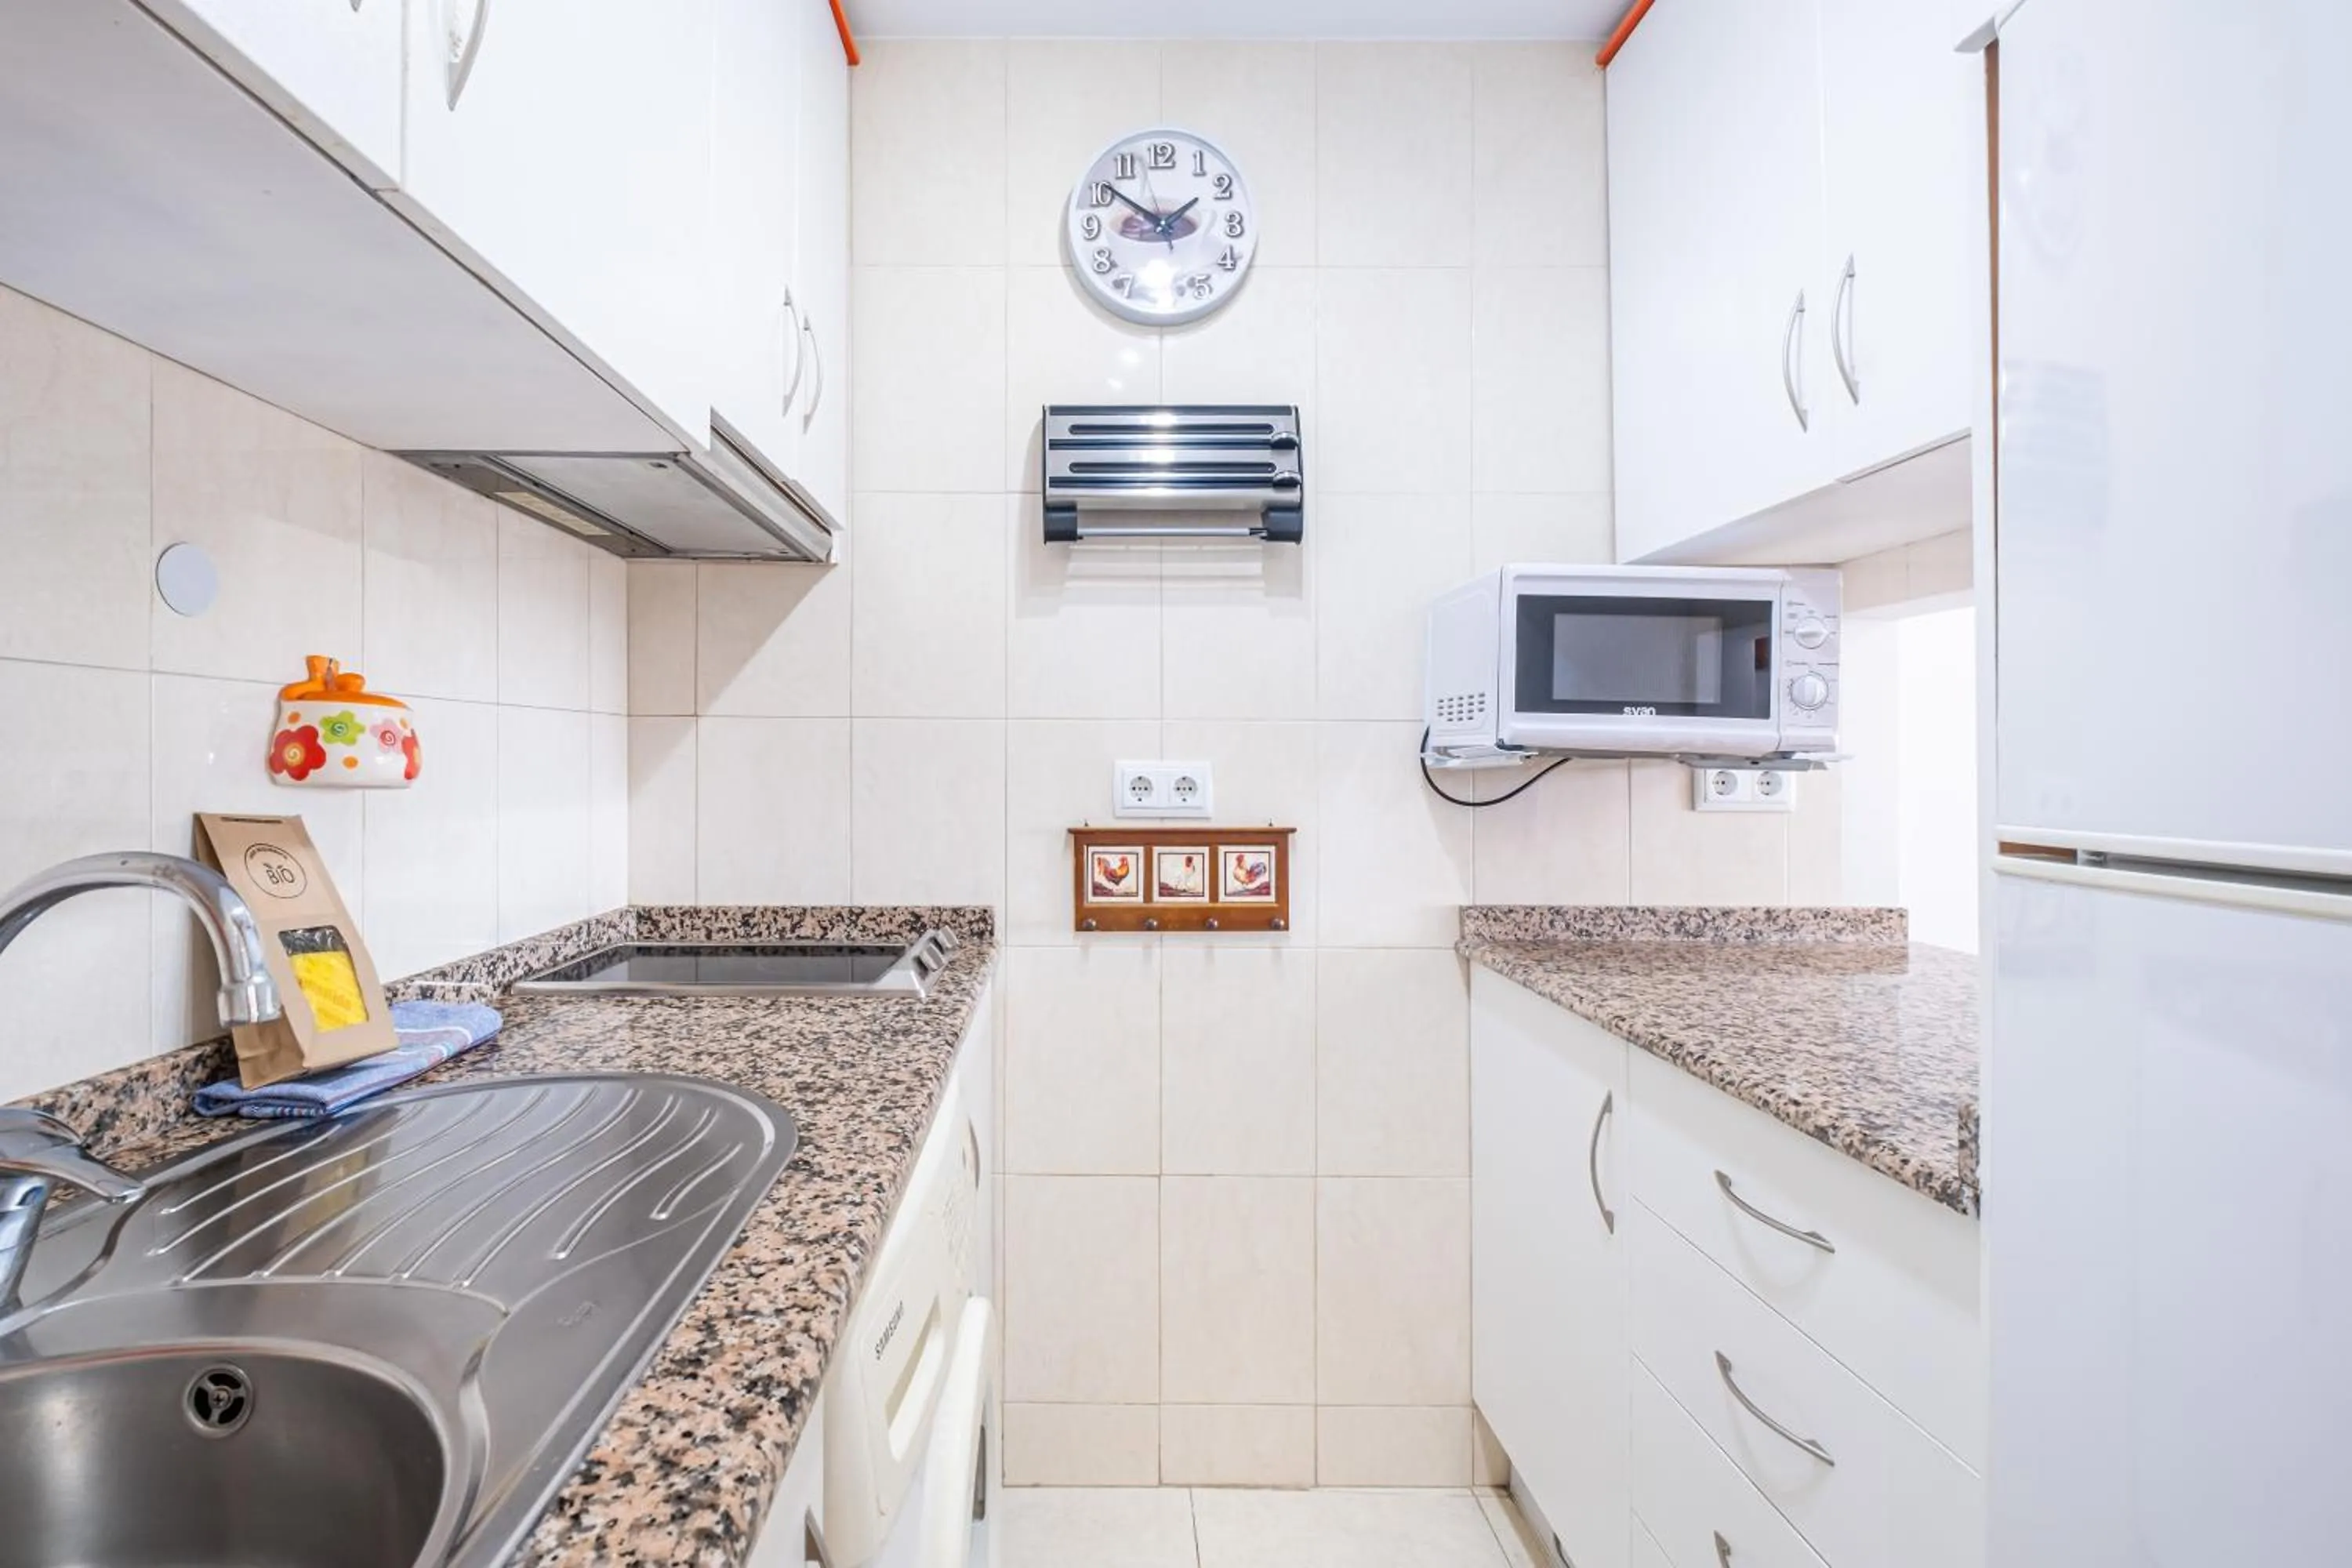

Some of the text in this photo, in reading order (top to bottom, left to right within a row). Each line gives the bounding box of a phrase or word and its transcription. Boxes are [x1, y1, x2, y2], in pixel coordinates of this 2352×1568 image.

[1115, 153, 1135, 180] 11
[1147, 143, 1175, 170] 12
[1192, 150, 1207, 177] 1
[1089, 180, 1115, 208] 10
[1214, 173, 1233, 200] 2
[1082, 212, 1101, 241] 9
[1224, 212, 1245, 238] 3
[1093, 247, 1113, 274] 8
[1217, 245, 1237, 270] 4
[1118, 274, 1135, 299] 7
[1192, 274, 1214, 300] 5
